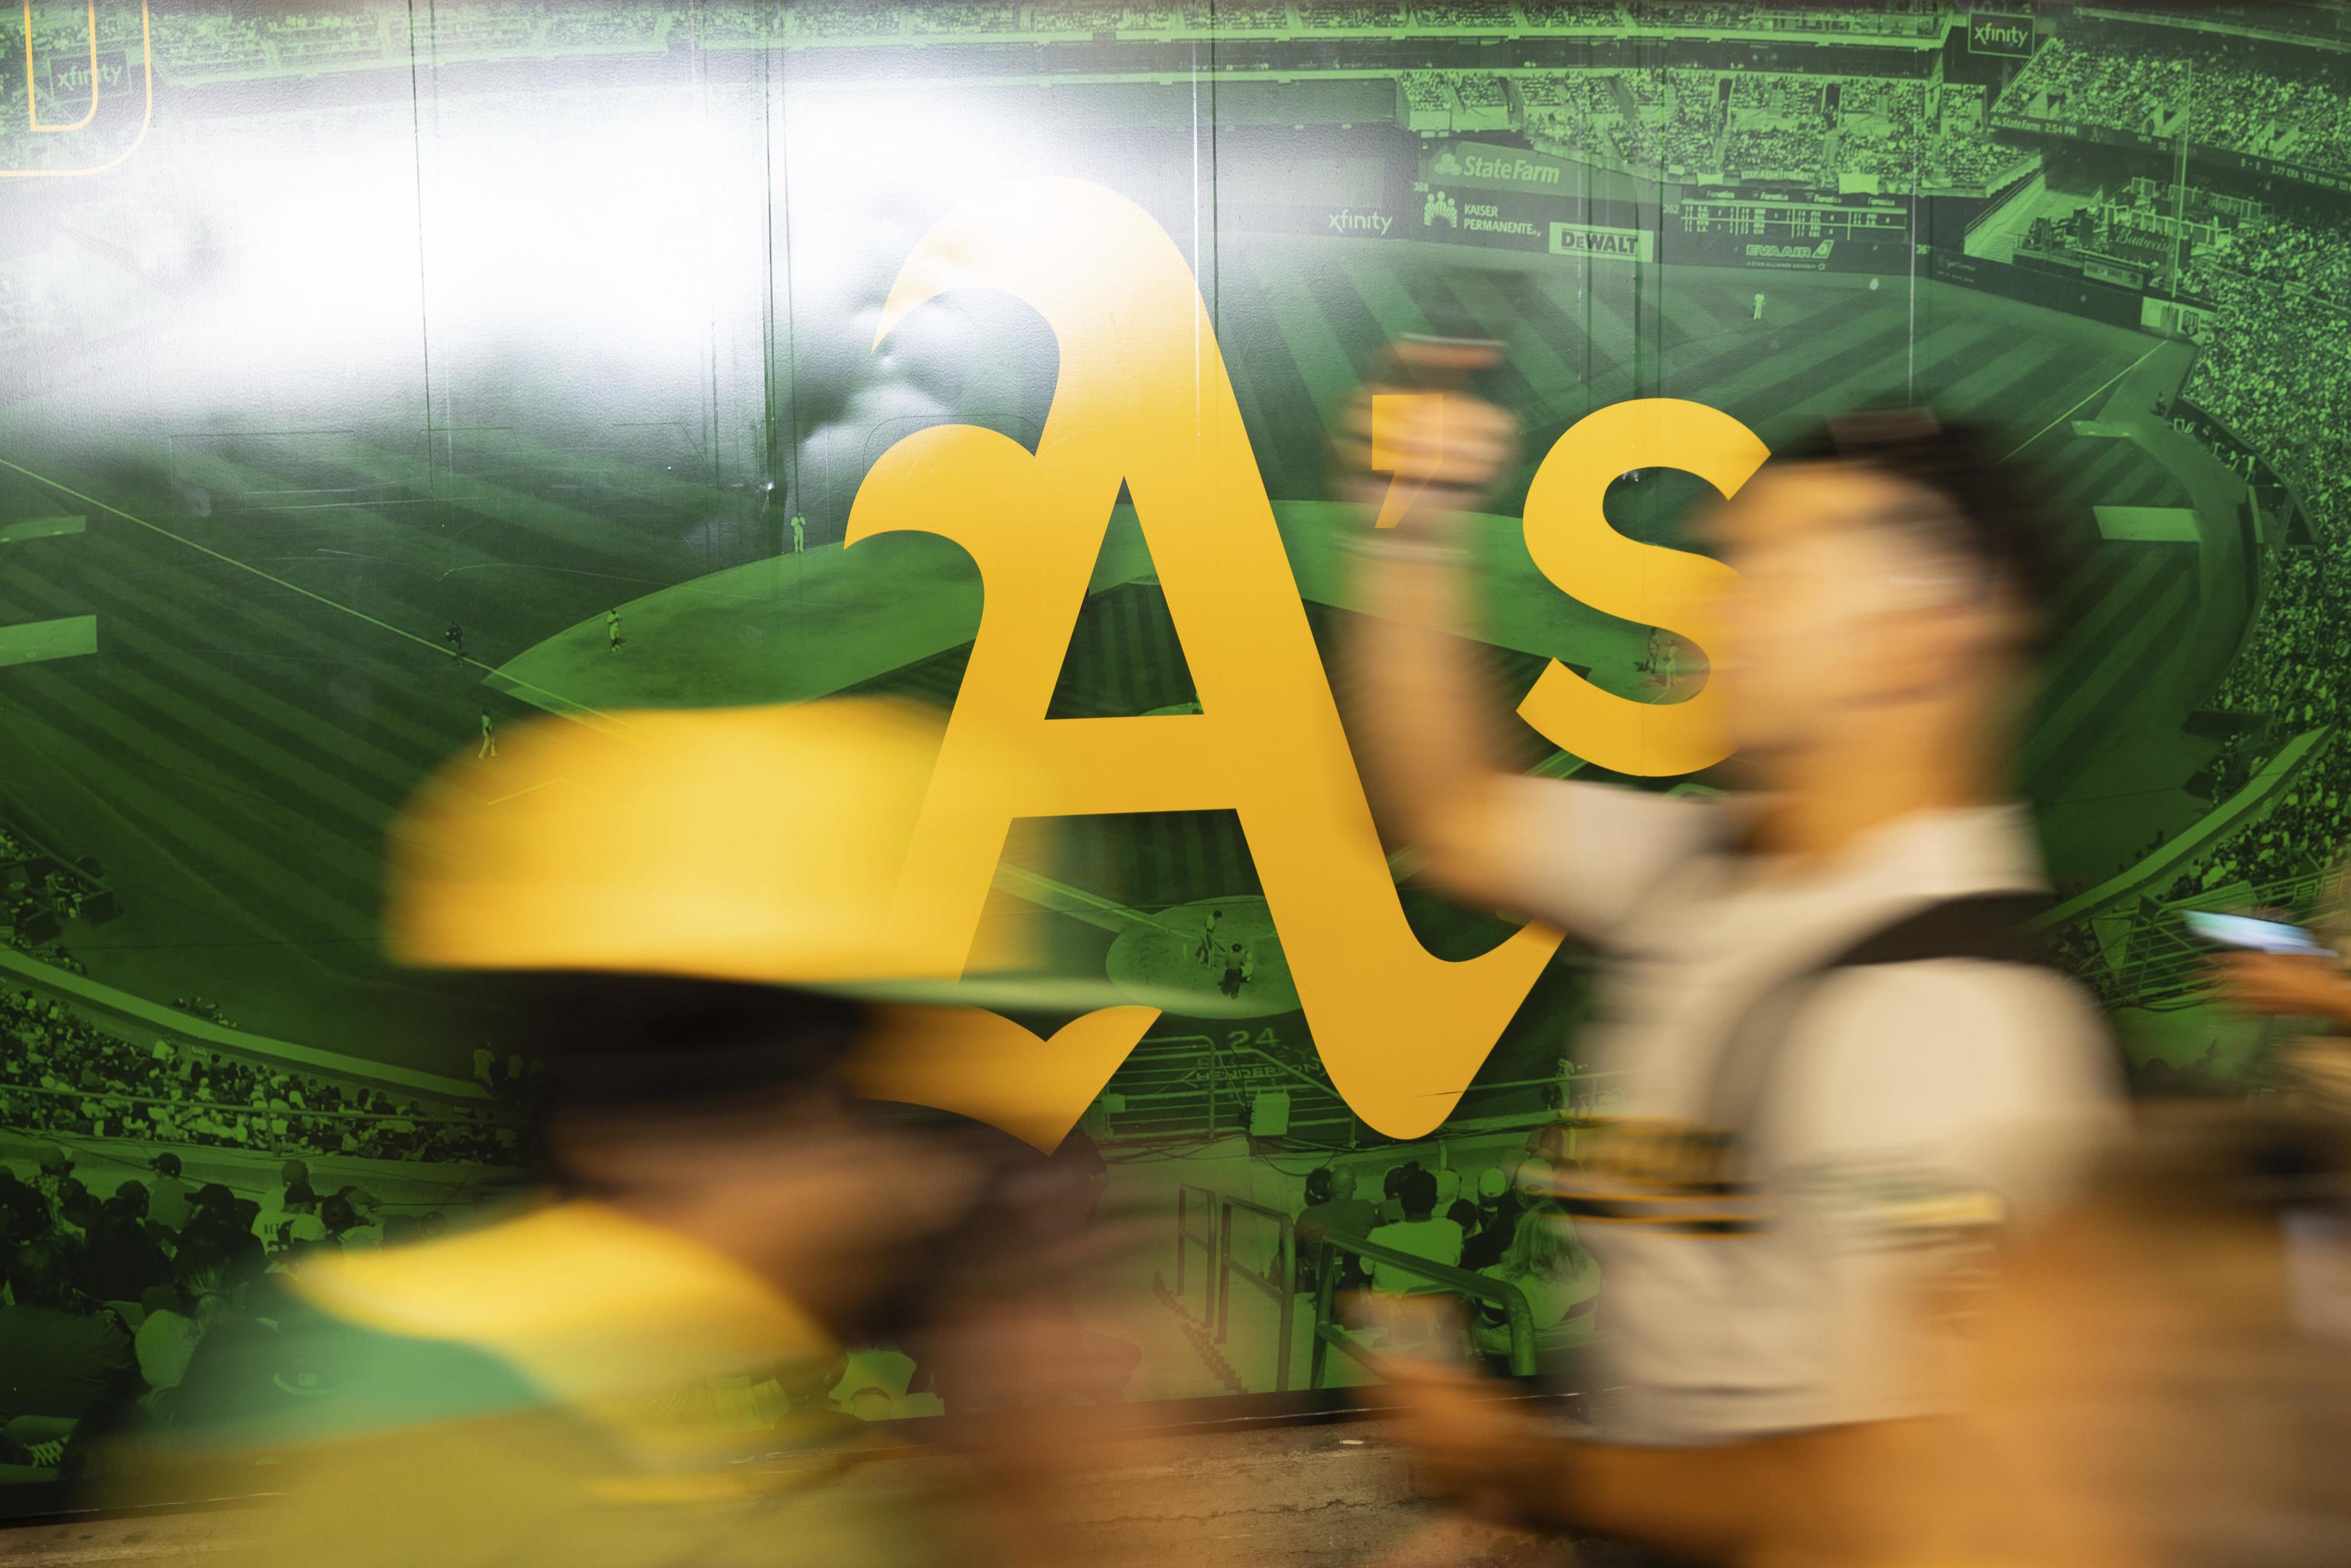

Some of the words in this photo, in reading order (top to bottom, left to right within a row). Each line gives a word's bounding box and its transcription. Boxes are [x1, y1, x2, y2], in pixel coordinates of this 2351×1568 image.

[1974, 22, 2029, 48] xfinity
[1329, 208, 1393, 236] xfinity
[1464, 204, 1498, 217] KAISER
[1228, 1027, 1280, 1050] 24
